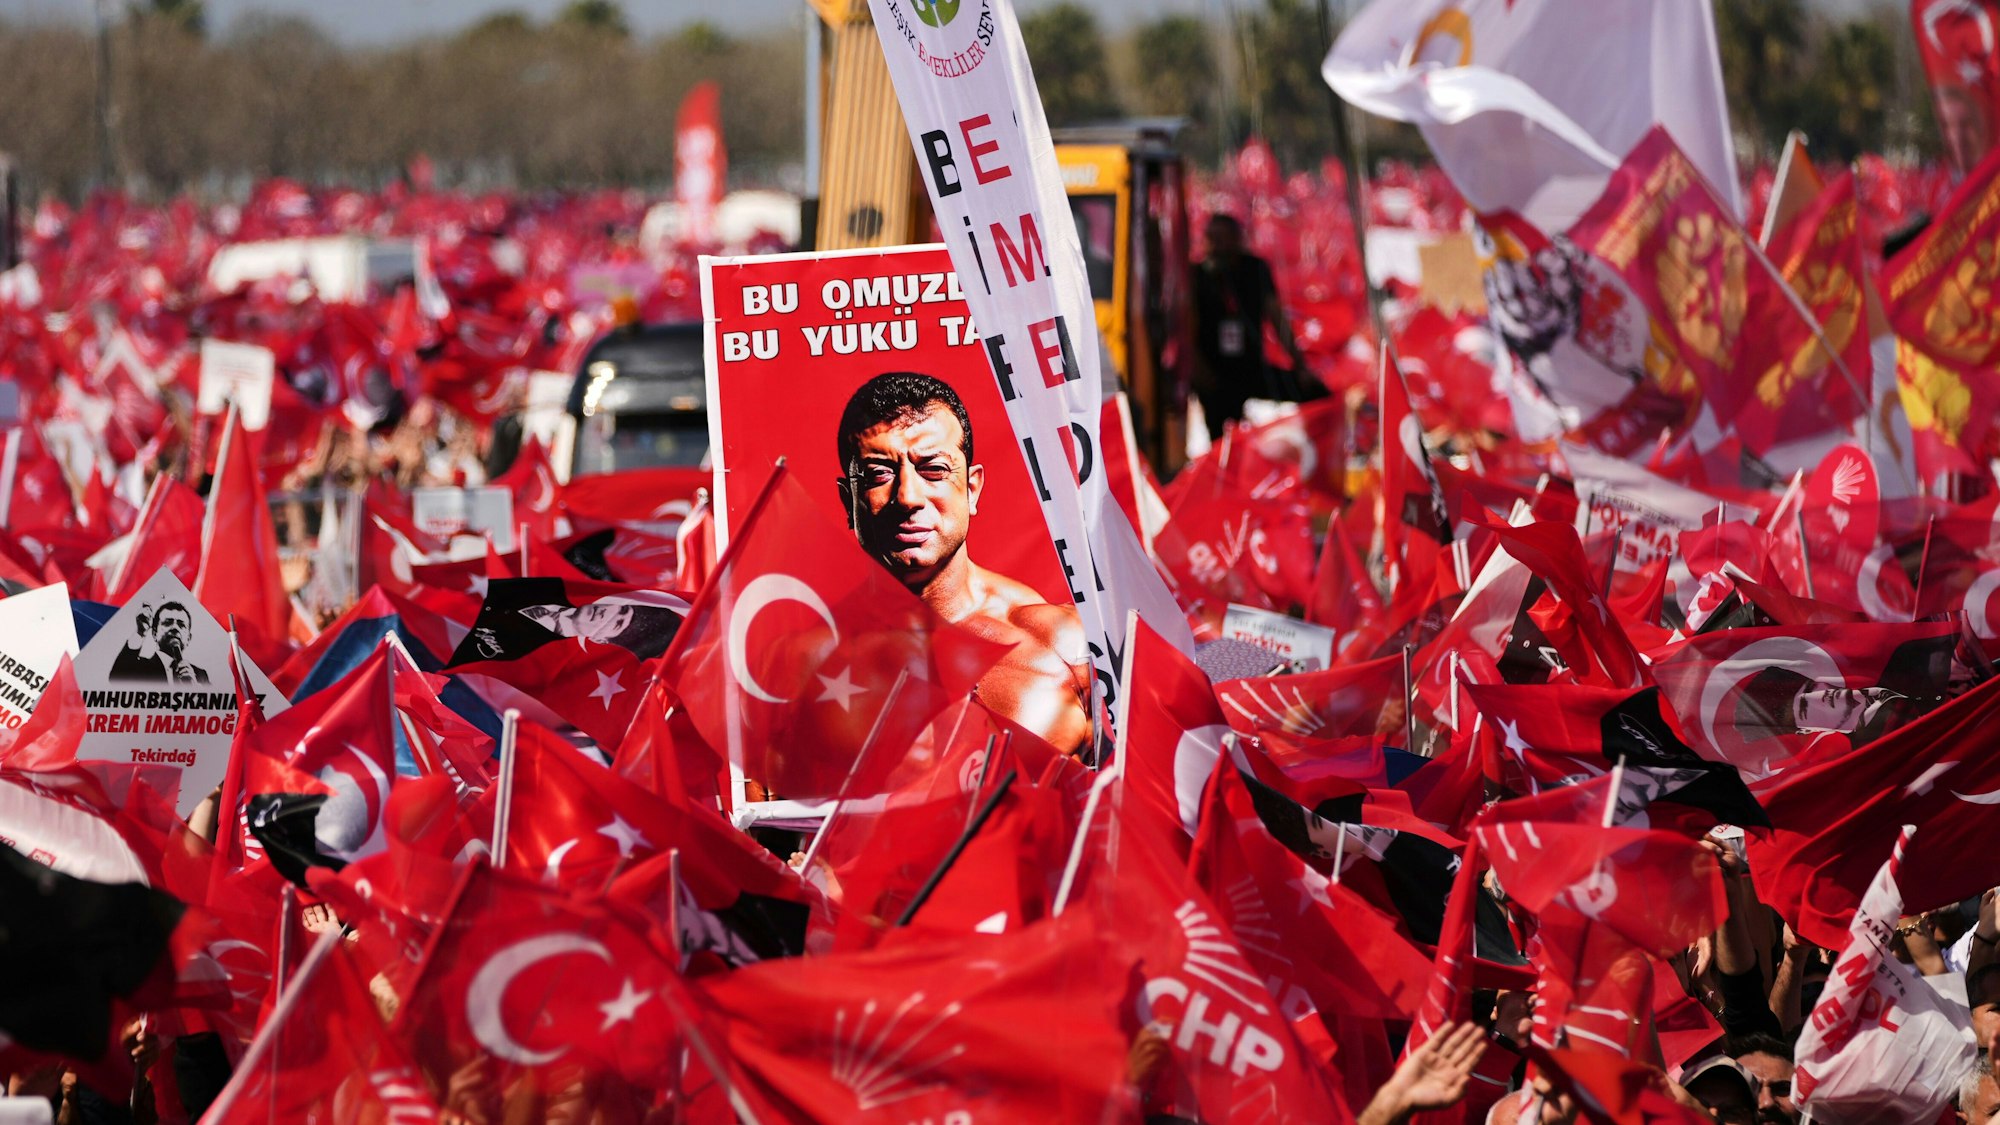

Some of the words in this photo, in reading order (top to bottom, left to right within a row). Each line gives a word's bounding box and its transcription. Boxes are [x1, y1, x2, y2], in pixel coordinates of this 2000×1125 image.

[742, 283, 799, 316] BU
[722, 329, 780, 362] BU
[801, 305, 919, 356] YÜKÜ
[144, 713, 239, 735] İMAMOĞ
[131, 749, 196, 767] Tekirdağ
[1136, 977, 1285, 1078] CHP
